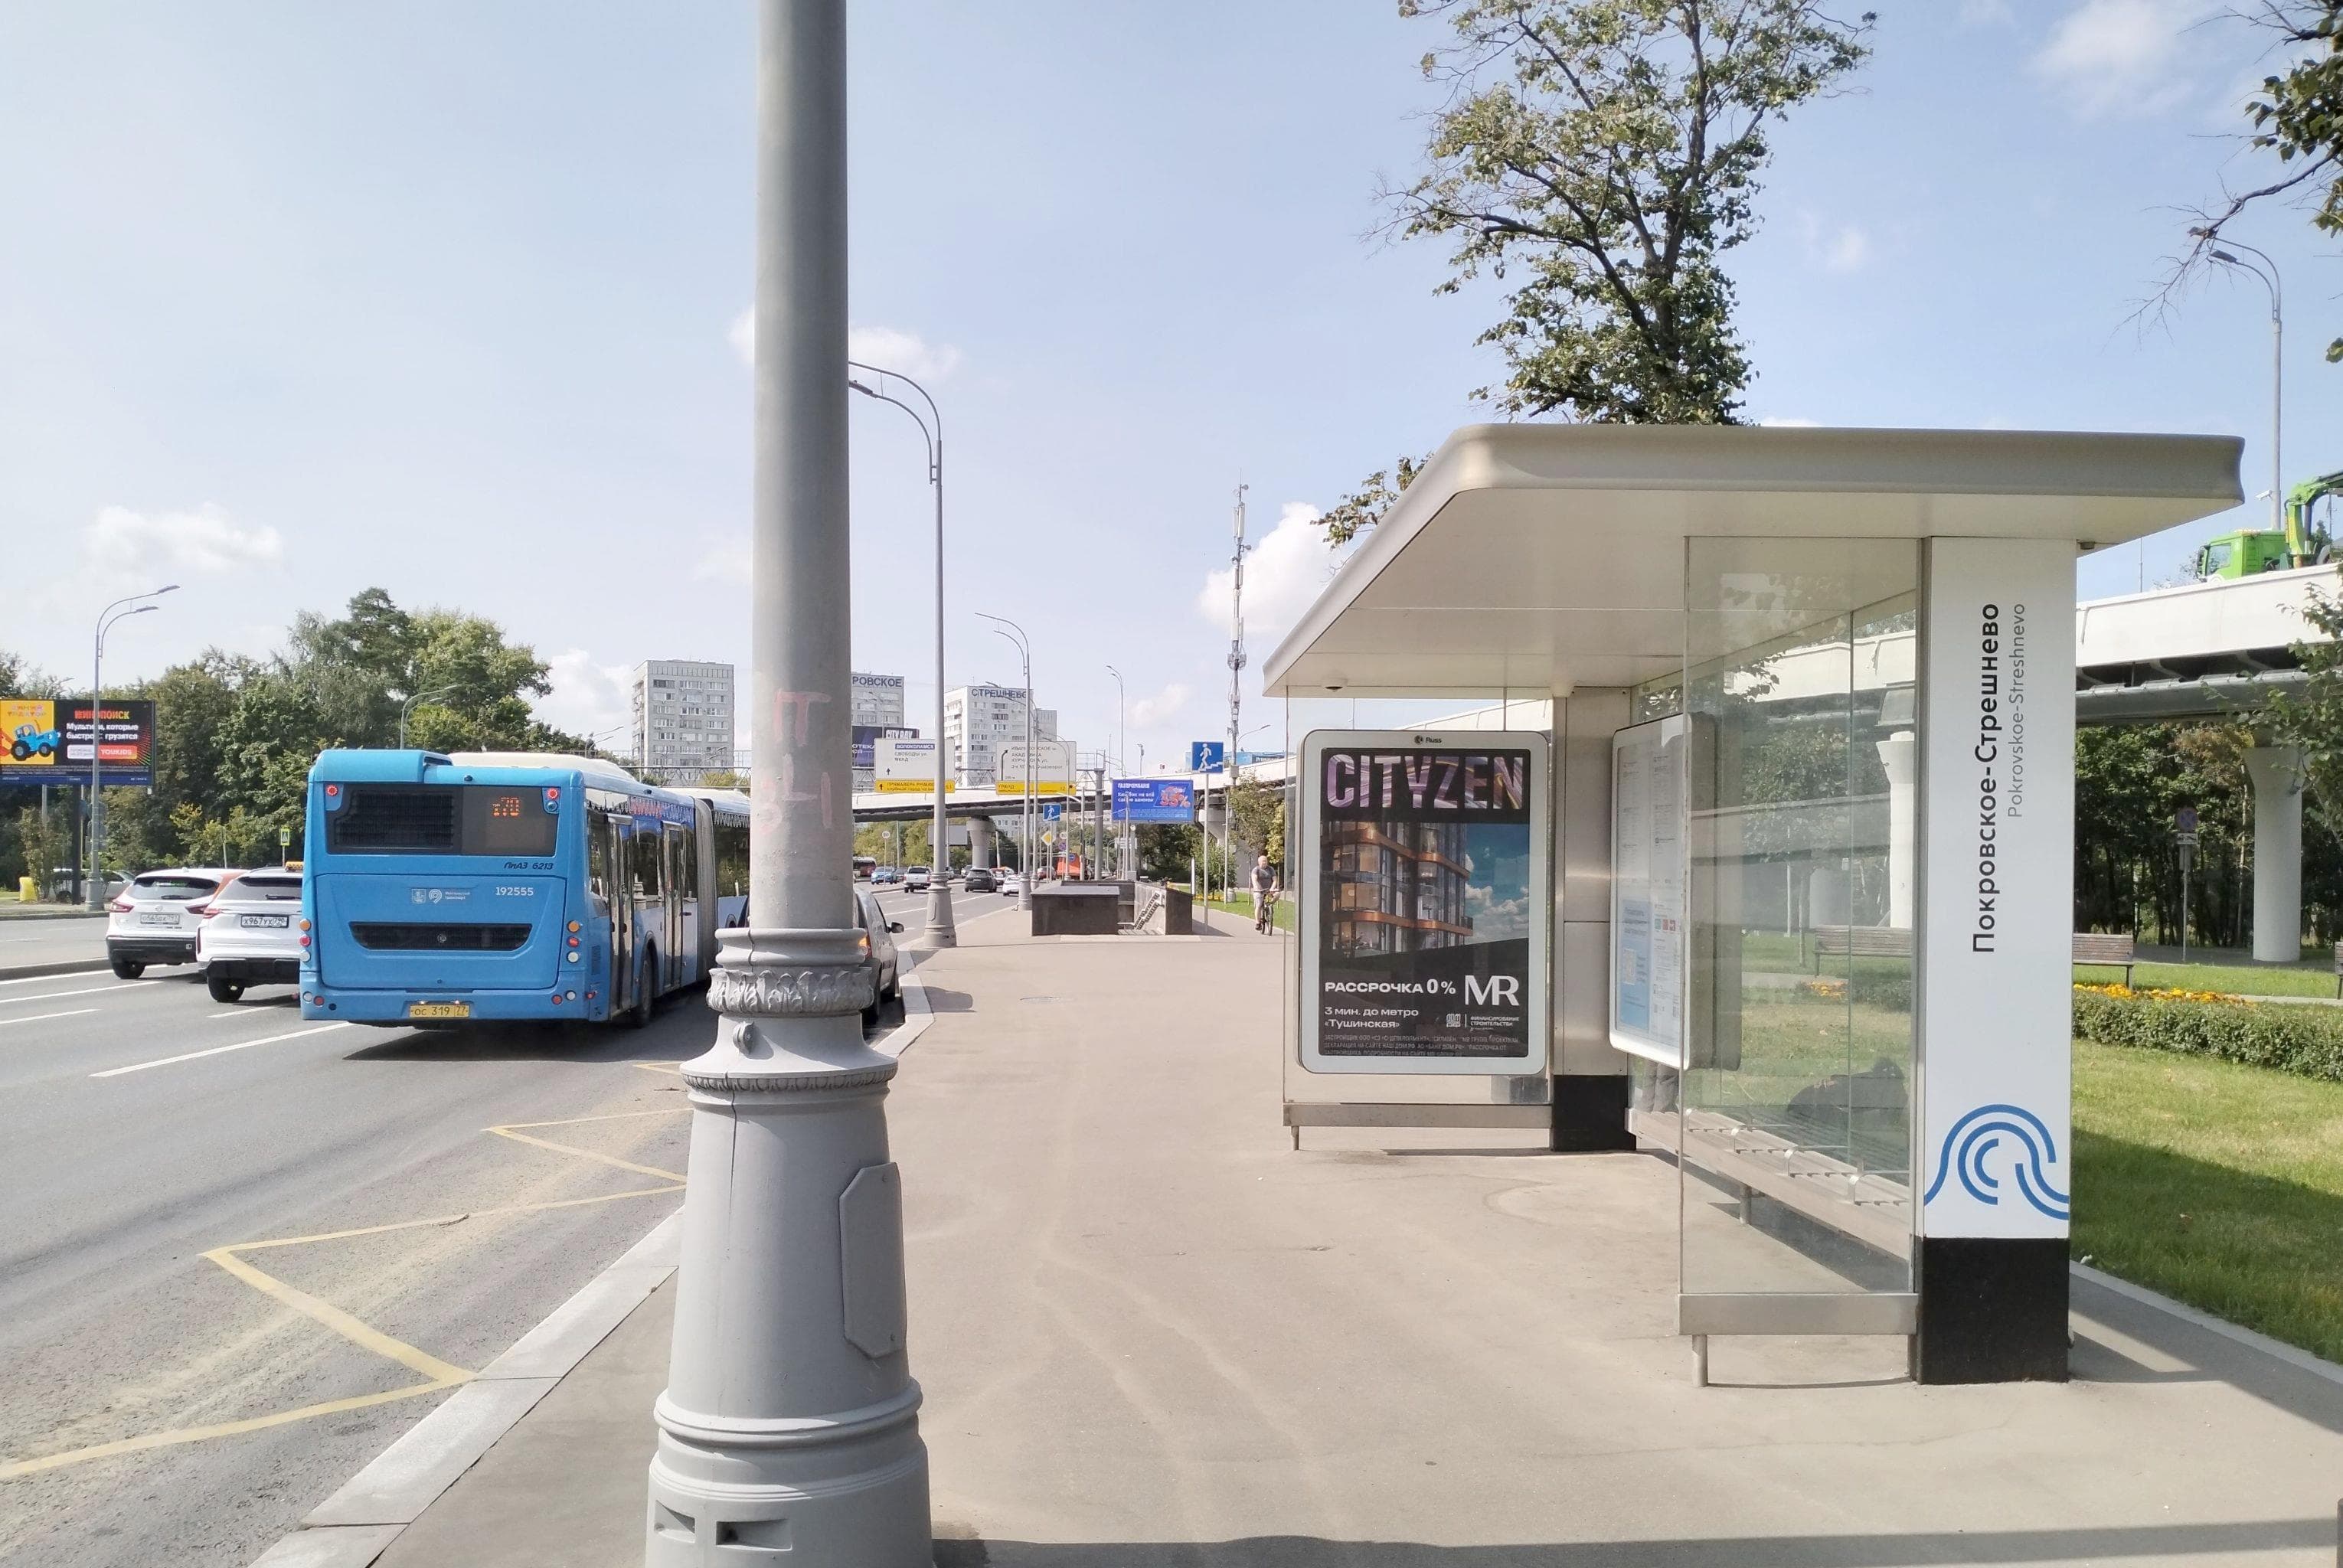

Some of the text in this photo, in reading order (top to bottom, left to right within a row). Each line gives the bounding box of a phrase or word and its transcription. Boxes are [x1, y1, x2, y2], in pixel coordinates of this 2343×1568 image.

[852, 676, 902, 687] РОВСКОЕ
[74, 710, 129, 719] КИНПОИСК
[2008, 603, 2025, 818] Pokrovskoe-Streshnevo
[1326, 753, 1523, 809] CITYZEN
[1973, 603, 2002, 952] Покровское-Стрешнево
[495, 887, 534, 896] 192555
[1325, 982, 1423, 993] РАССРОЧКА
[1465, 975, 1520, 1006] MR
[432, 1006, 449, 1016] 319
[1325, 1007, 1332, 1015] 3
[1381, 1009, 1419, 1018] метро
[1325, 1020, 1400, 1029] «Тушинская»
